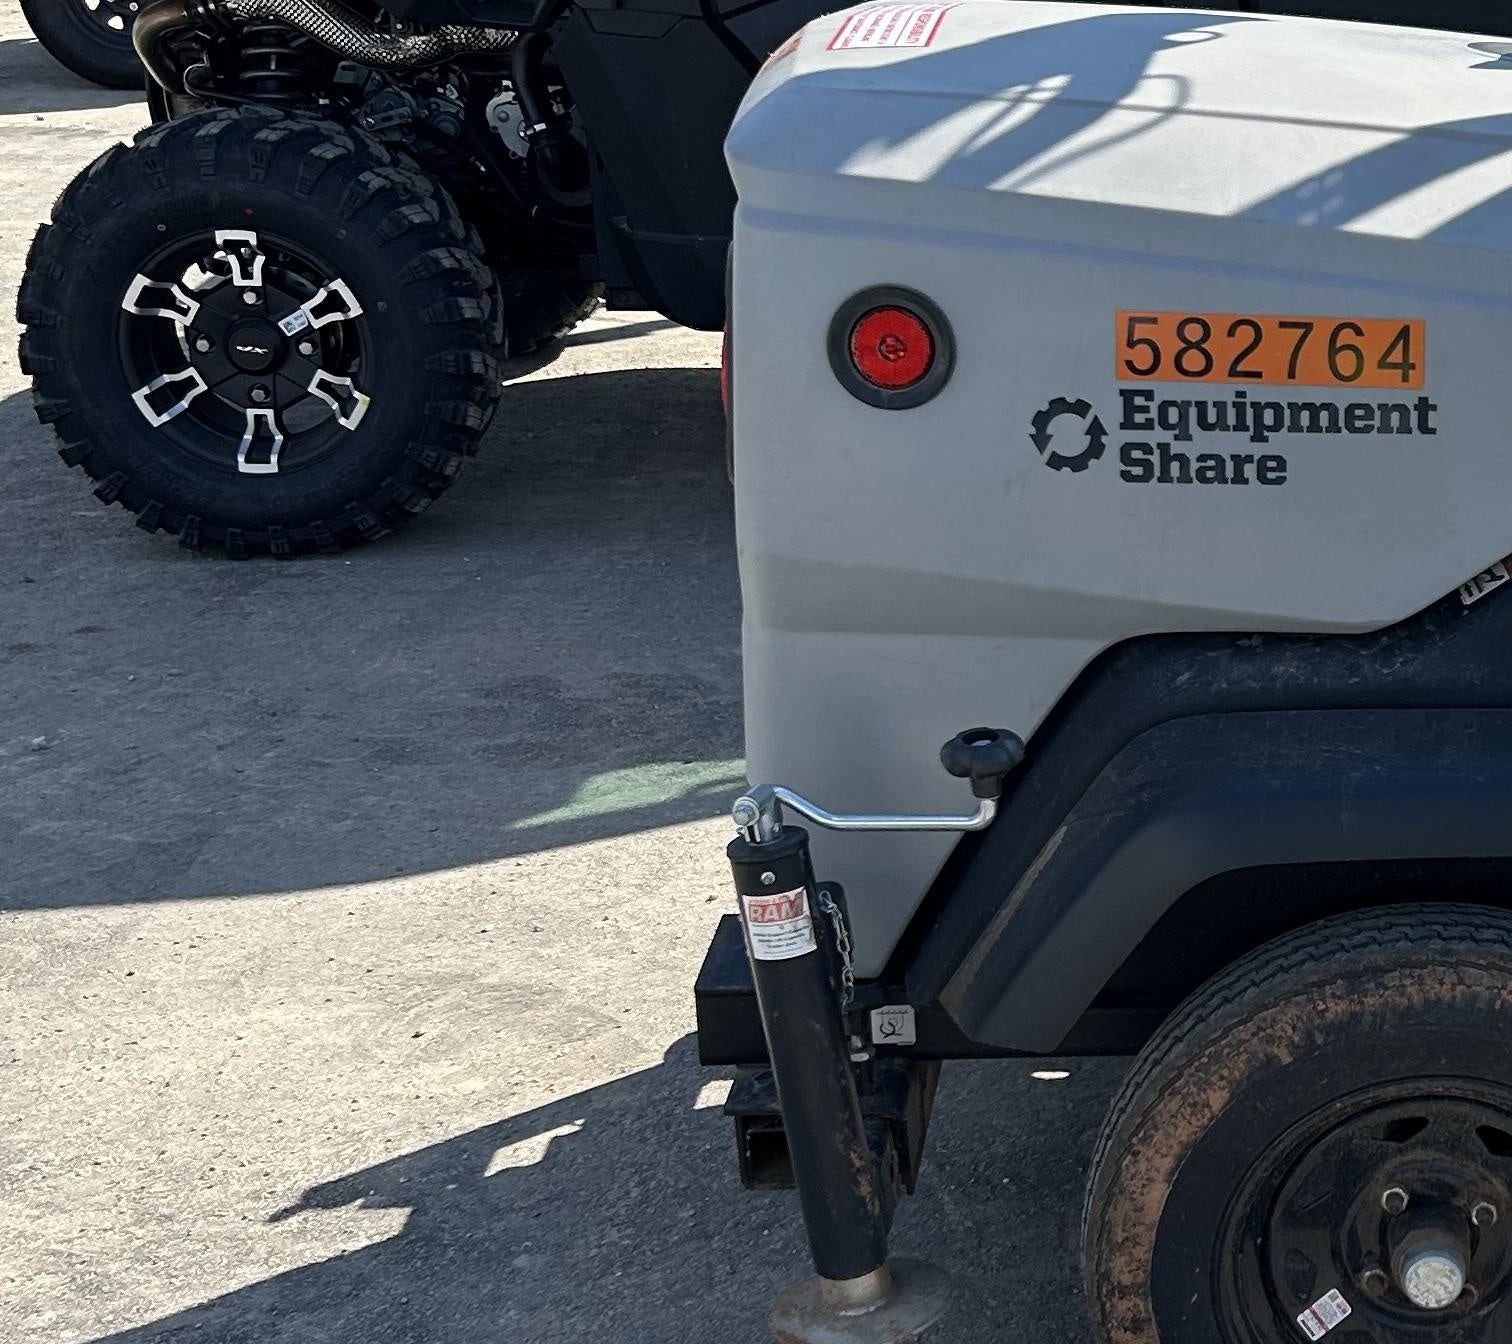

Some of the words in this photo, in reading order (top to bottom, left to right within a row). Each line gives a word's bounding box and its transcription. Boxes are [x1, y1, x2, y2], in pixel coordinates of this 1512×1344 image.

[1124, 316, 1416, 383] 582764
[1119, 389, 1438, 443] Equipment
[1119, 442, 1288, 485] Share
[750, 897, 804, 922] RAM
